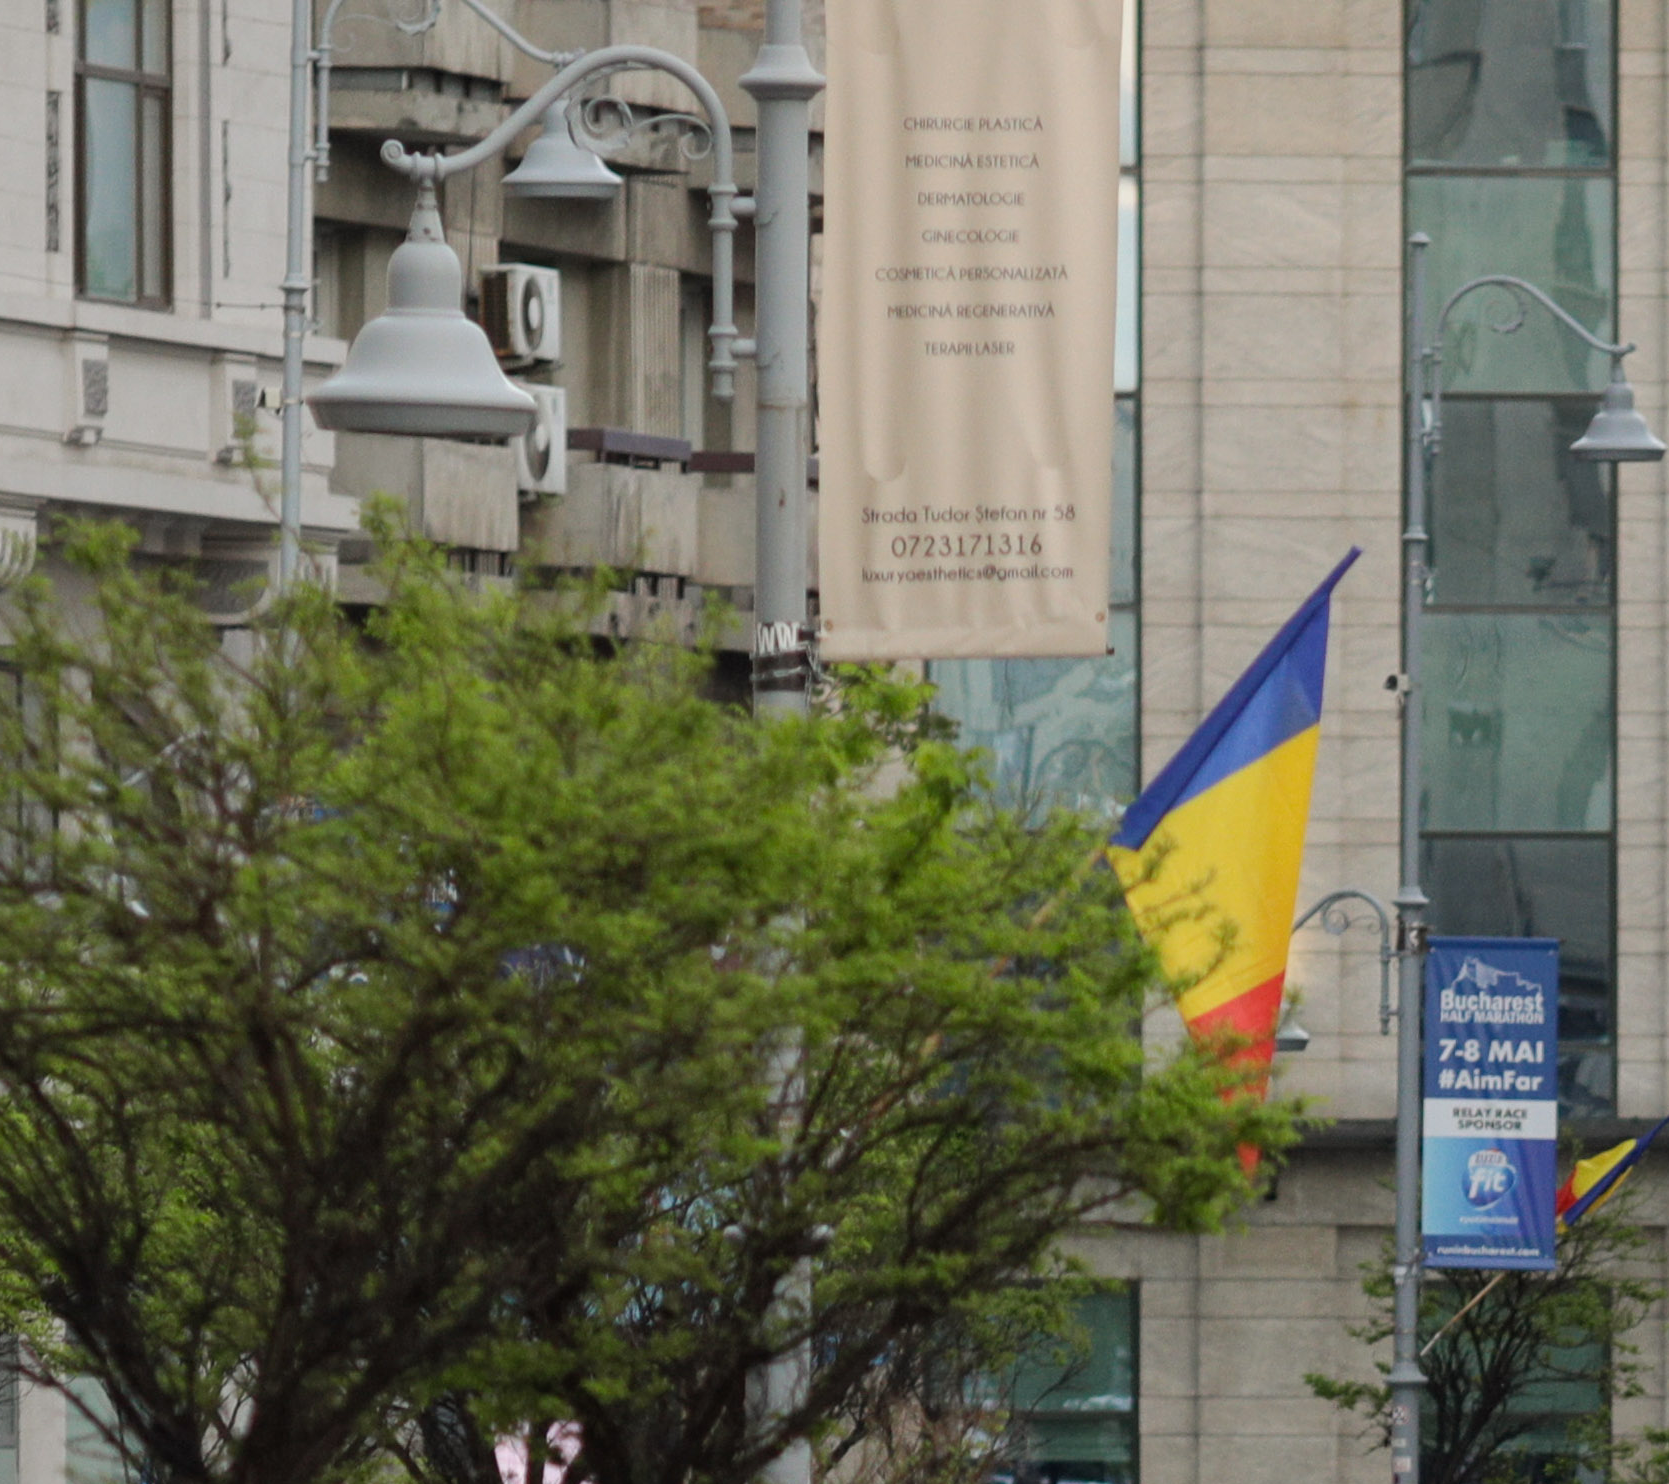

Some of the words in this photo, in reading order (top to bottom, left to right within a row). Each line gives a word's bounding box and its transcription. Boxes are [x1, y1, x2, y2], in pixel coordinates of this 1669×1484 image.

[903, 116, 974, 132] CHIRURGIE
[905, 153, 973, 169] MEDICINĂ
[917, 191, 1025, 206] DERMATOLOGIE
[922, 229, 1020, 243] GINECOLOGIE
[887, 303, 952, 320] MEDICINĂ
[924, 341, 974, 356] TERAPII
[975, 341, 1015, 356] LASER
[862, 505, 917, 524] Strada
[923, 505, 969, 523] Tudor
[1032, 508, 1046, 520] nr
[1053, 504, 1075, 522] 58
[891, 533, 1043, 558] 0723171316
[862, 562, 1073, 584] luxuryaesthetics@gmail.com
[1440, 988, 1545, 1011] Bucharest
[1440, 1010, 1472, 1023] HALF
[1474, 1010, 1545, 1025] MARATHON
[1439, 1038, 1481, 1062] 7-8
[1488, 1040, 1545, 1064] MAI
[1438, 1068, 1544, 1091] #AimFar
[1453, 1107, 1492, 1118] RELAY
[1495, 1108, 1527, 1119] RACE
[1458, 1120, 1522, 1131] SPONSOR
[1468, 1167, 1507, 1199] fit
